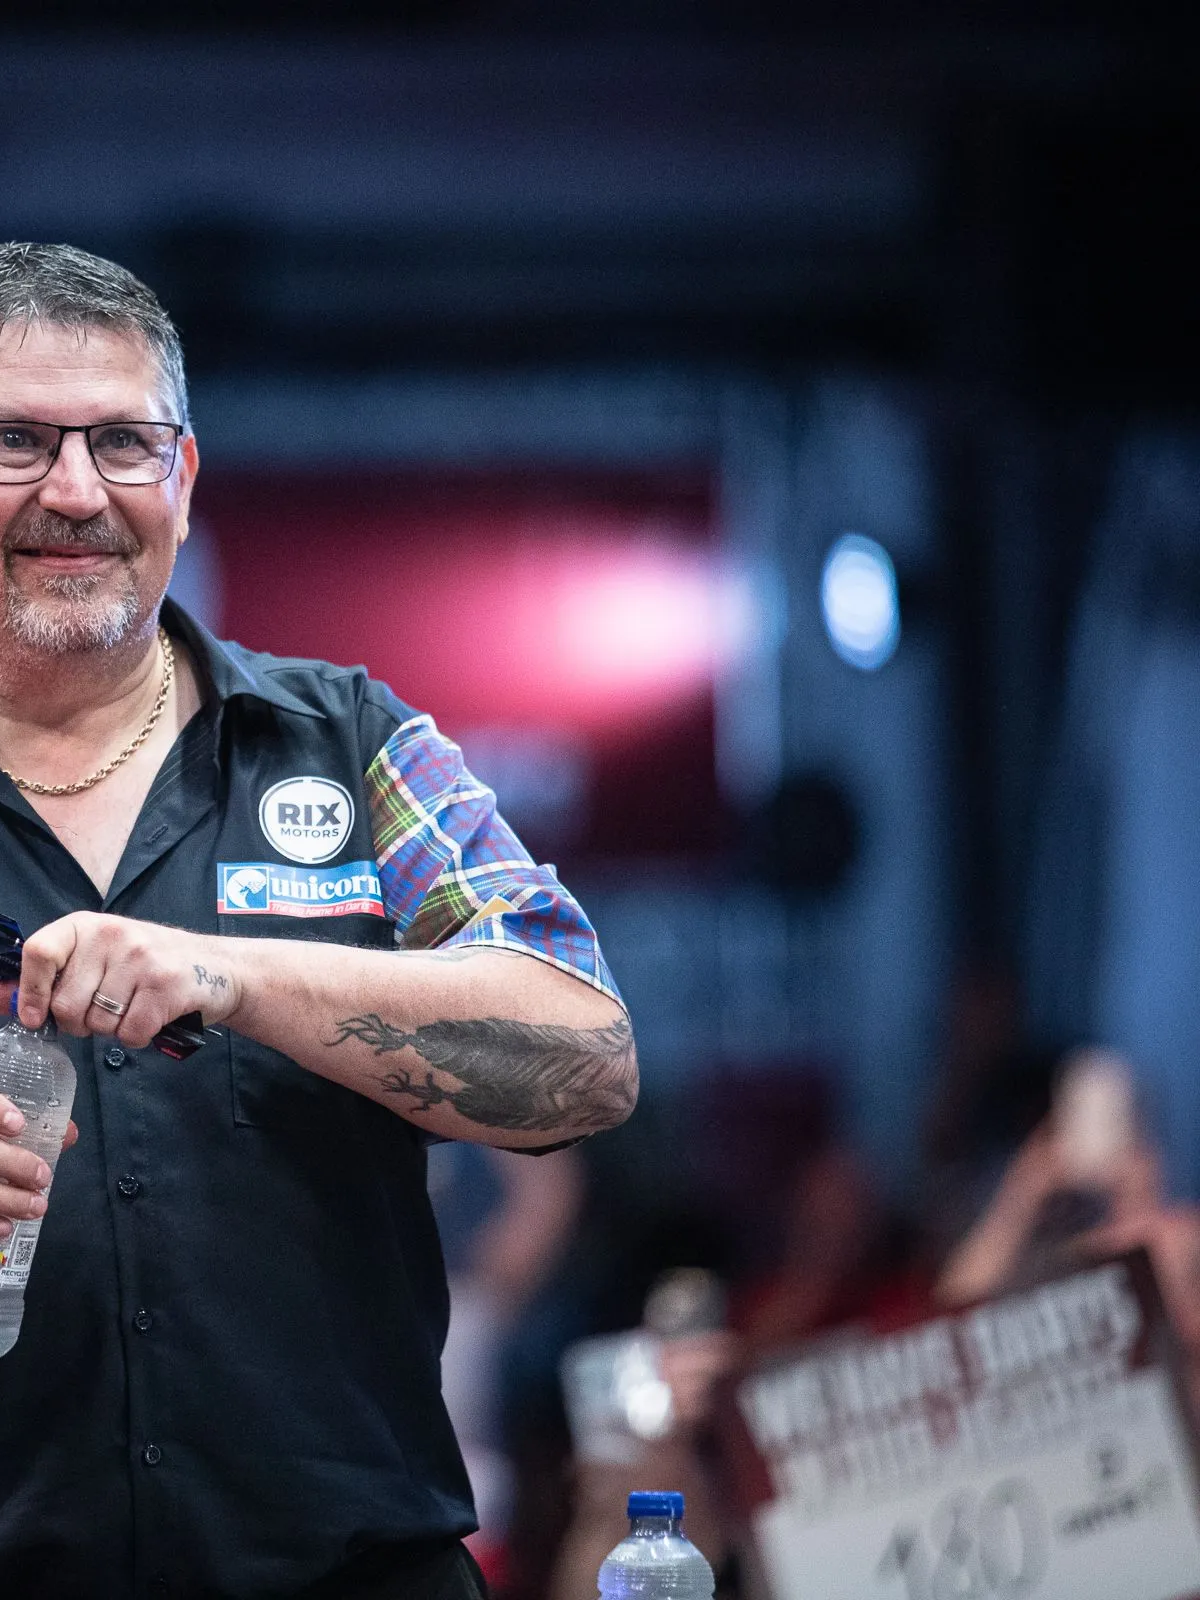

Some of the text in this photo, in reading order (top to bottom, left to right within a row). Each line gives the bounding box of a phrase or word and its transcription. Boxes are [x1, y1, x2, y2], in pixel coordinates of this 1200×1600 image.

[277, 801, 341, 827] RIX
[280, 827, 339, 838] MOTORS
[270, 874, 382, 900] unicorn
